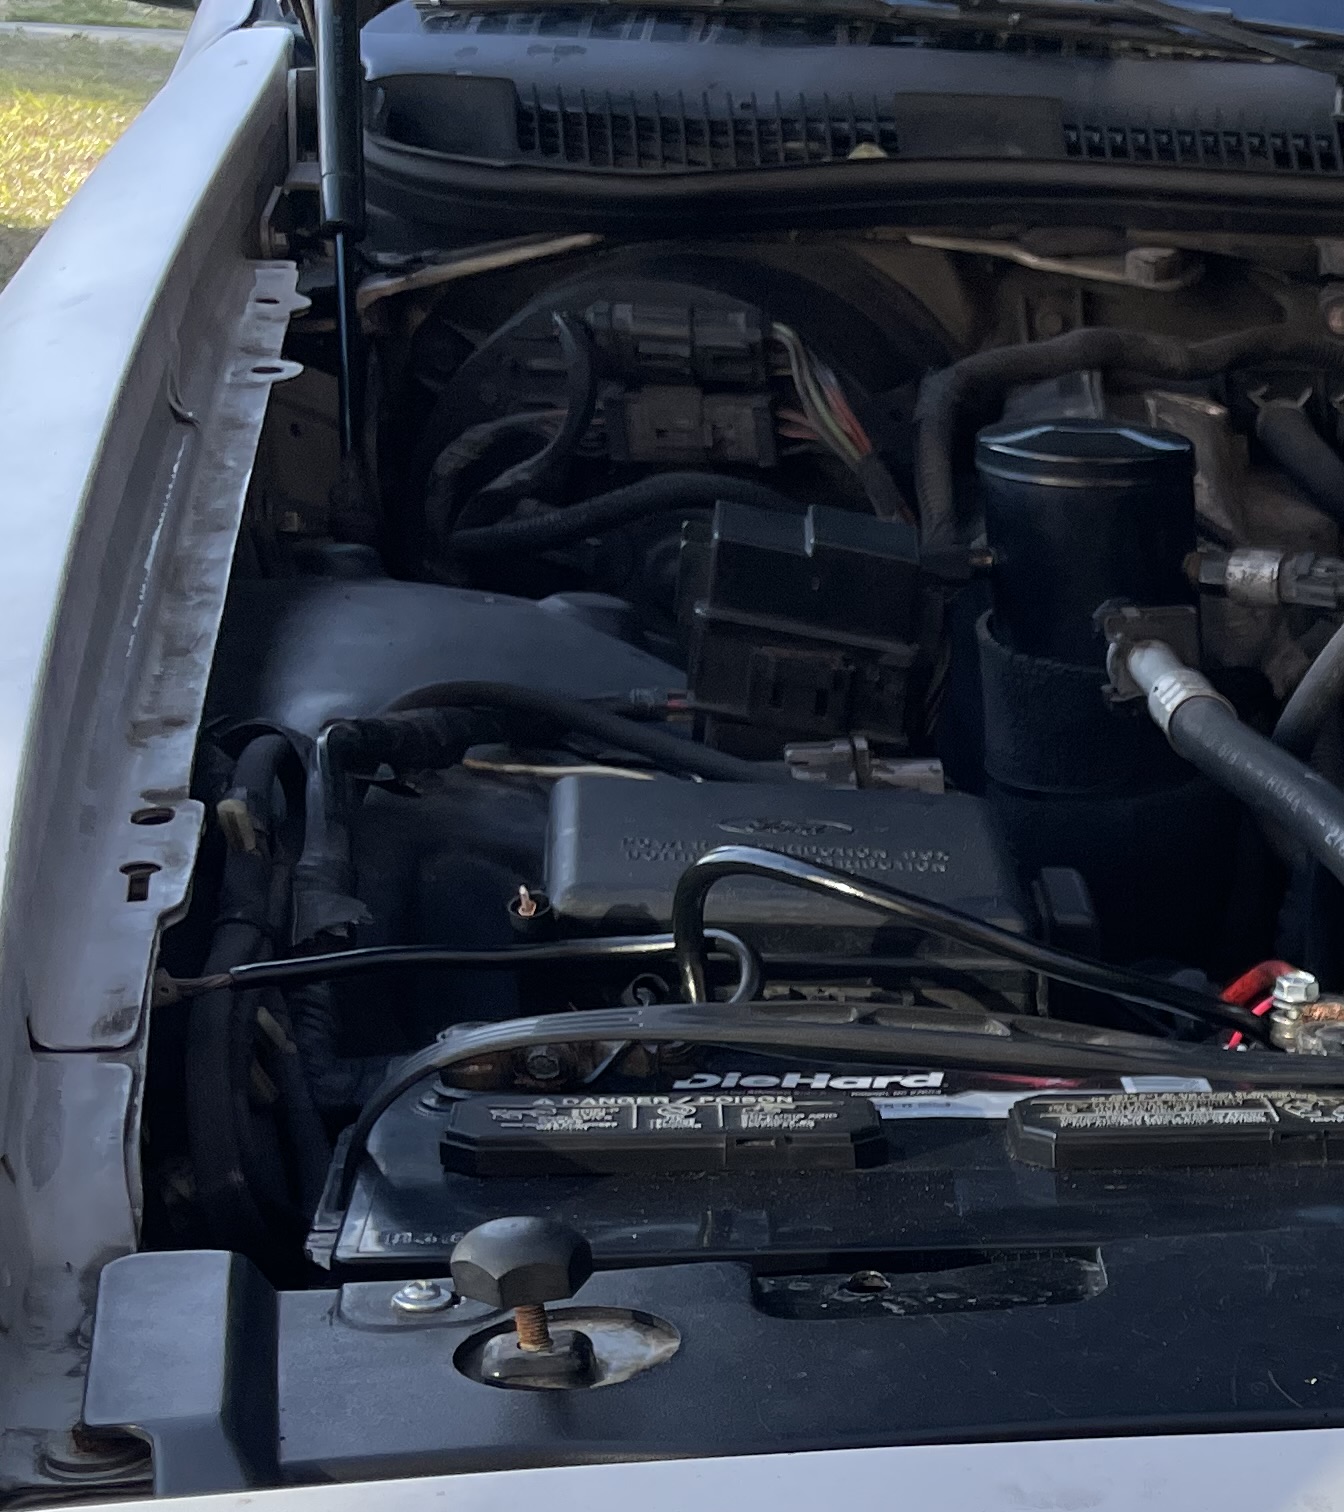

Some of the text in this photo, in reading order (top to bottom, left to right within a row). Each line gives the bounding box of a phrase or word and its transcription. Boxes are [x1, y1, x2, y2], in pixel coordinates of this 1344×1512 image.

[672, 1071, 946, 1090] DieHard
[562, 1095, 670, 1106] DANGER
[699, 1095, 794, 1106] POISON
